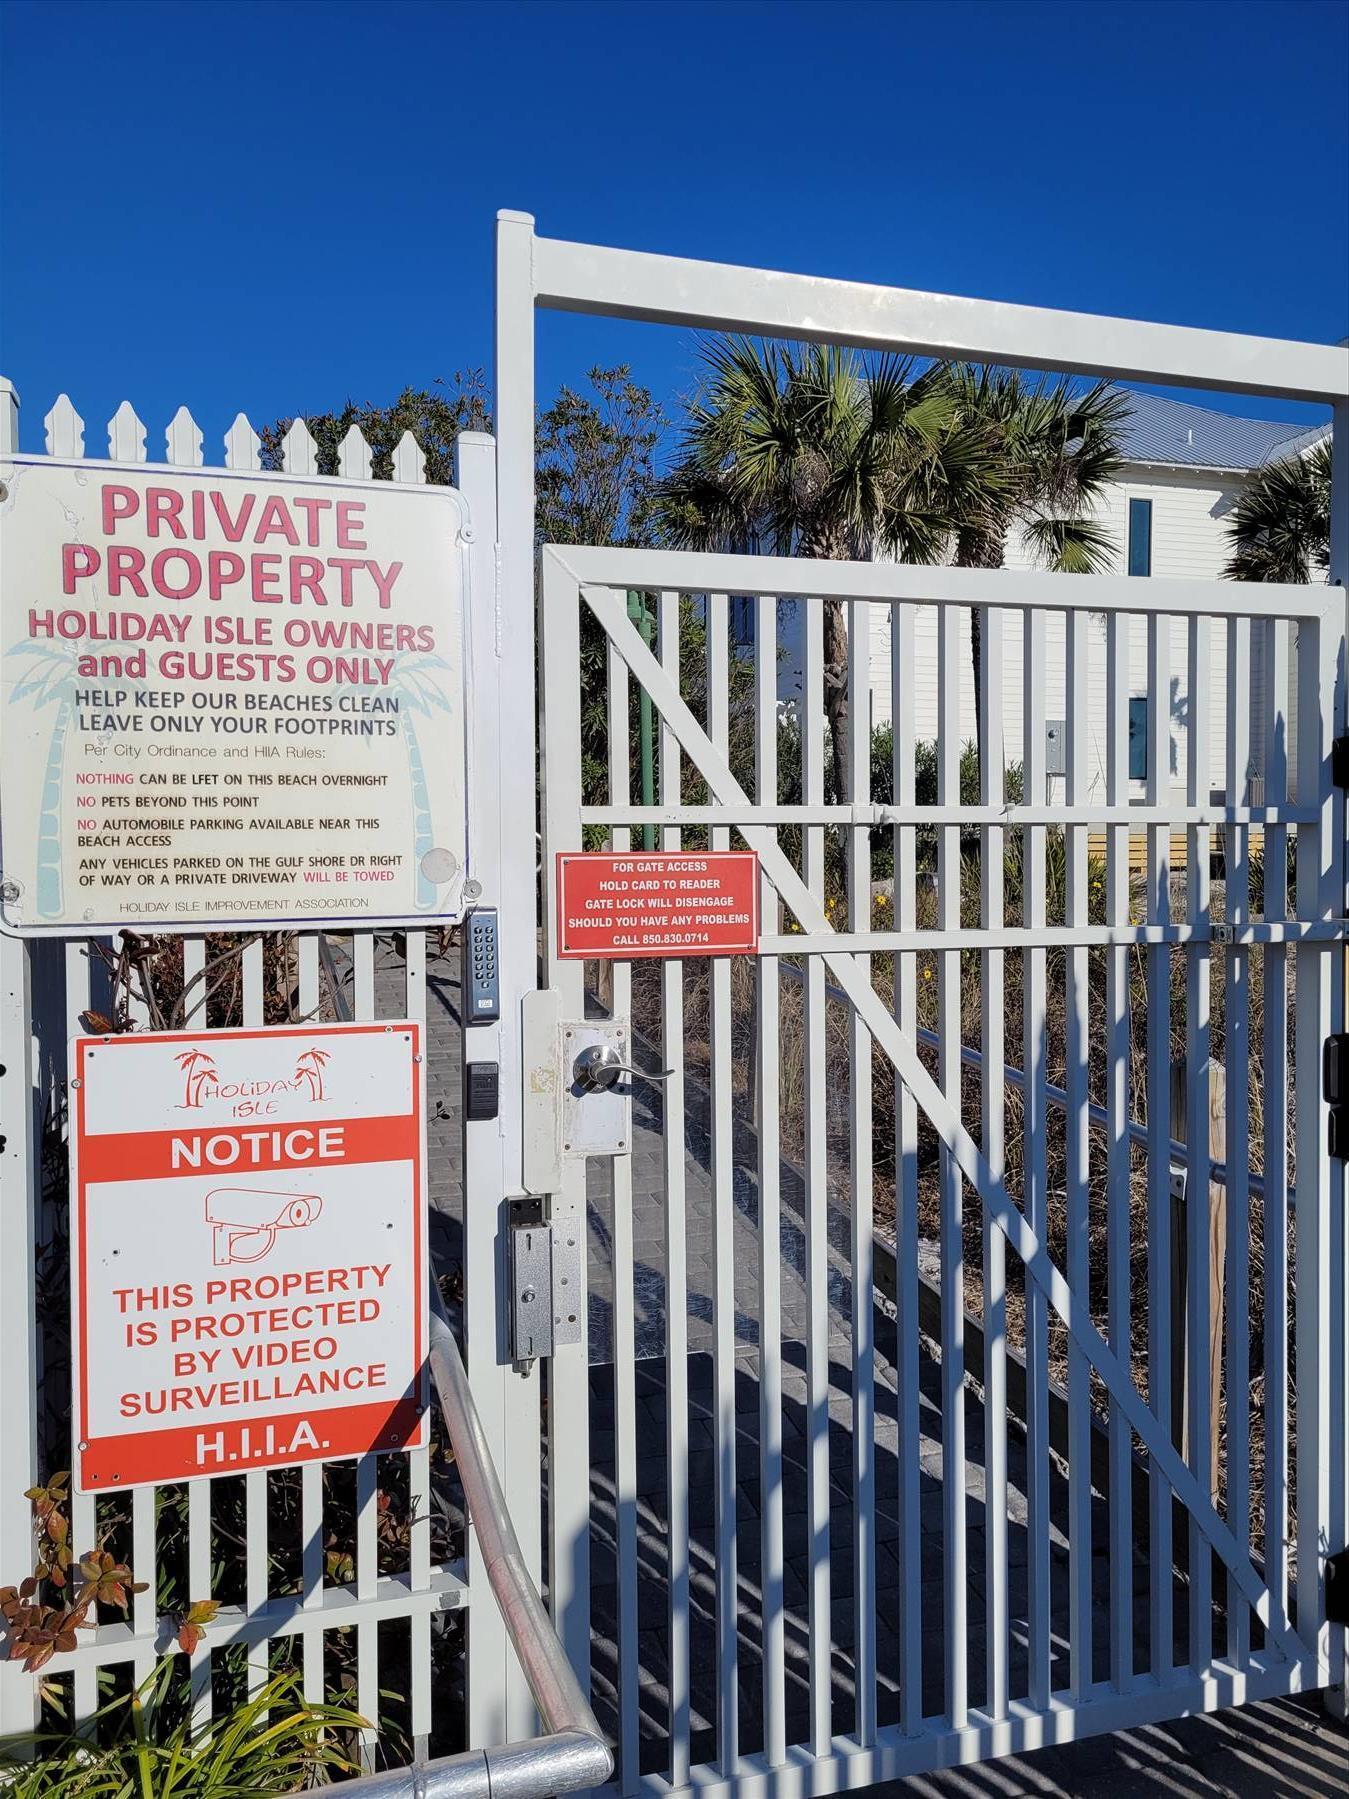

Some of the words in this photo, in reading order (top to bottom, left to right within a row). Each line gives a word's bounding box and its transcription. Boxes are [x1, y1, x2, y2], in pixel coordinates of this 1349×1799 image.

[101, 484, 367, 550] PRIVATE
[61, 543, 403, 609] PROPERTY
[28, 609, 193, 643] HOLIDAY
[204, 616, 273, 646] ISLE
[284, 619, 435, 652] OWNERS
[77, 649, 146, 678] and
[159, 651, 296, 682] GUESTS
[306, 656, 395, 685] ONLY
[75, 690, 128, 708] HELP
[135, 691, 185, 709] KEEP
[192, 693, 238, 710] OUR
[244, 694, 333, 712] BEACHES
[338, 697, 399, 713] CLEAN
[79, 714, 143, 732] LEAVE
[150, 715, 204, 732] ONLY
[211, 716, 268, 734] YOUR
[274, 717, 397, 736] FOOTPRINTS
[84, 744, 106, 756] Per
[114, 744, 140, 759] City
[148, 744, 217, 758] Ordinance
[223, 745, 248, 758] and
[286, 747, 325, 759] Rules:
[76, 773, 134, 785] NOTHING
[139, 774, 167, 785] CAN
[172, 774, 187, 785] BE
[223, 774, 242, 785] ON
[248, 775, 273, 785] THIS
[278, 775, 317, 786] BEACH
[322, 775, 388, 786] OVERNIGHT
[77, 797, 96, 807] NO
[101, 797, 130, 808] PETS
[135, 797, 187, 808] BEYOND
[192, 797, 218, 807] THIS
[223, 797, 259, 807] POINT
[77, 820, 97, 831] NO
[102, 819, 185, 831] AUTOMOBILE
[190, 819, 244, 830] PARKING
[249, 818, 314, 830] AVAILABLE
[319, 818, 350, 829] NEAR
[355, 818, 379, 829] THIS
[78, 836, 120, 847] BEACH
[126, 835, 172, 847] ACCESS
[79, 858, 106, 869] ANY
[112, 858, 168, 869] VEHICLES
[173, 857, 221, 868] PARKED
[226, 857, 244, 868] ON
[249, 856, 270, 867] THE
[275, 856, 305, 867] GULF
[309, 856, 345, 867] SHORE
[350, 855, 366, 866] DR
[370, 855, 402, 866] RIGHT
[613, 863, 634, 872] FOR
[637, 862, 664, 872] GATE
[667, 862, 707, 872] ACCESS
[79, 874, 95, 886] OF
[100, 874, 131, 885] WAY
[137, 874, 155, 885] OR
[160, 873, 169, 884] A
[175, 873, 227, 885] PRIVATE
[232, 872, 297, 884] DRIVEWAY
[303, 872, 331, 882] WILL
[335, 871, 349, 882] BE
[353, 871, 394, 882] TOWED
[600, 881, 628, 891] HOLD
[632, 881, 660, 890] CARD
[663, 880, 676, 890] TO
[680, 880, 720, 889] READER
[119, 902, 170, 913] HOLIDAY
[175, 901, 199, 912] ISLE
[205, 900, 289, 911] IMPROVEMENT
[295, 898, 368, 910] ASSOCIATION
[586, 899, 613, 909] GATE
[617, 899, 644, 908] LOCK
[647, 898, 672, 908] WILL
[676, 897, 734, 907] DISENGAGE
[569, 918, 612, 928] SHOULD
[616, 917, 638, 927] YOU
[641, 917, 668, 926] HAVE
[671, 916, 692, 925] ANY
[695, 914, 749, 924] PROBLEMS
[613, 935, 639, 945] CALL
[643, 933, 708, 944] 850.830.0714
[232, 1101, 279, 1118] ISLE
[171, 1127, 345, 1169] NOTICE
[113, 1284, 194, 1313] THIS
[206, 1264, 392, 1304] PROPERTY
[126, 1322, 158, 1348] IS
[171, 1299, 380, 1343] PROTECTED
[174, 1349, 221, 1377] BY
[232, 1336, 338, 1369] VIDEO
[120, 1363, 387, 1418] SURVEILLANCE
[196, 1420, 330, 1465] H.I.I.A.
